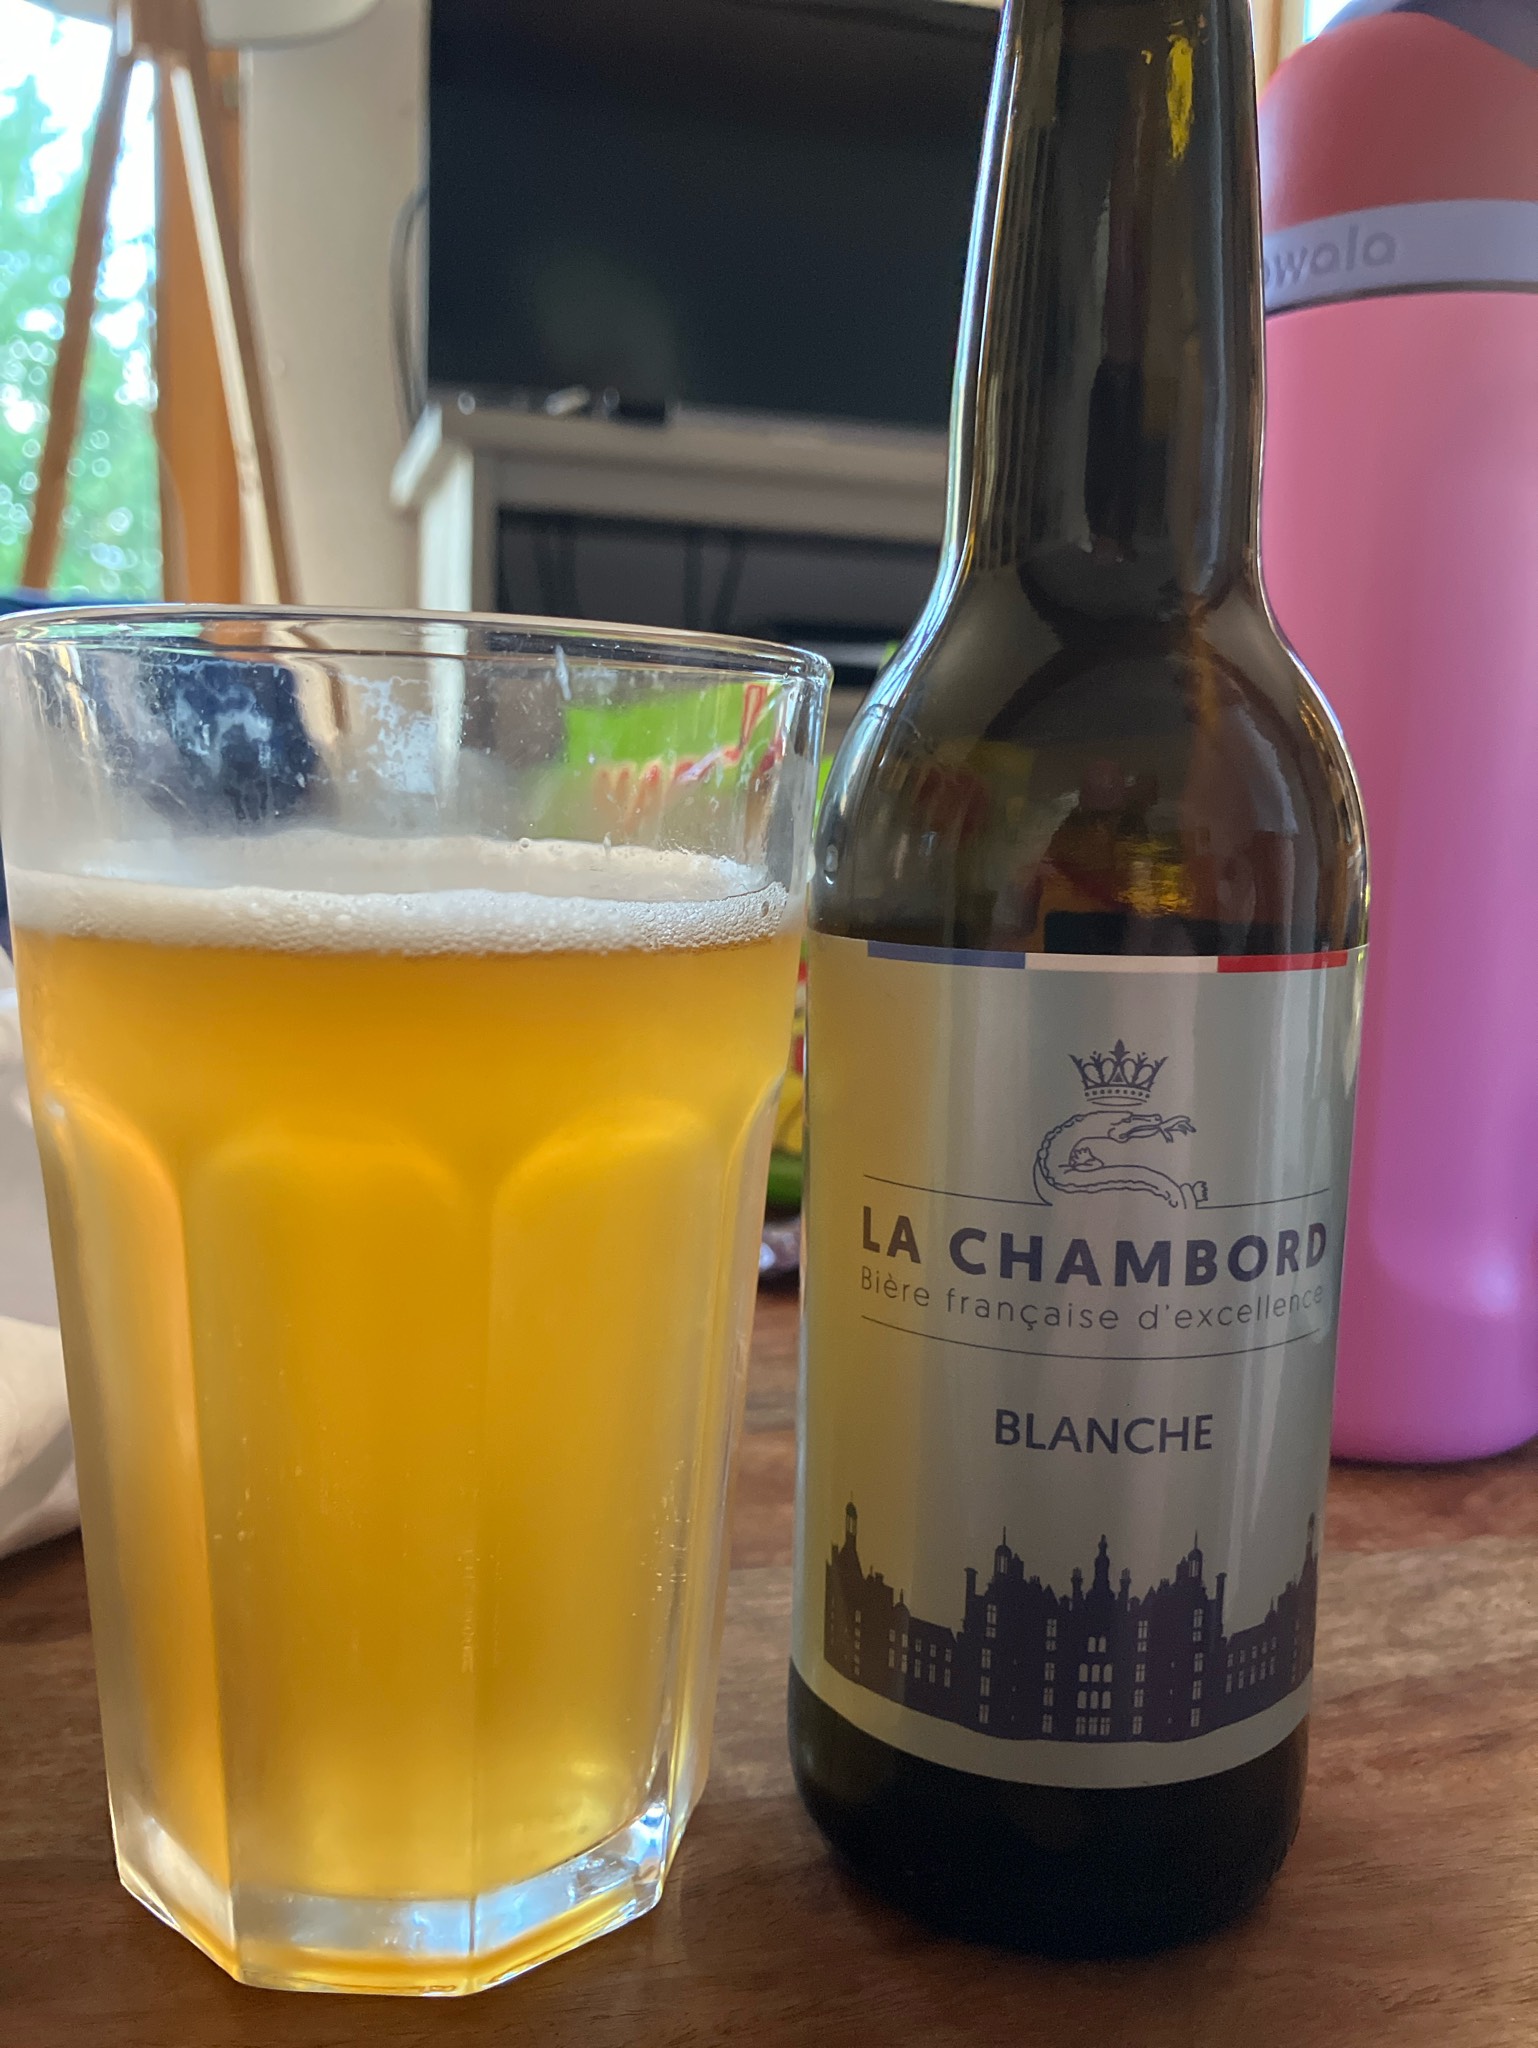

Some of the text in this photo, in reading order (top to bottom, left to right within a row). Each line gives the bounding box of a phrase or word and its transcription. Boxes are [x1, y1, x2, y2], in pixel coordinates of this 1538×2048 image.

[862, 1206, 1327, 1287] LA CHAMBORD
[861, 1266, 1323, 1331] Bière française d'excellence
[995, 1409, 1213, 1454] BLANCHE
